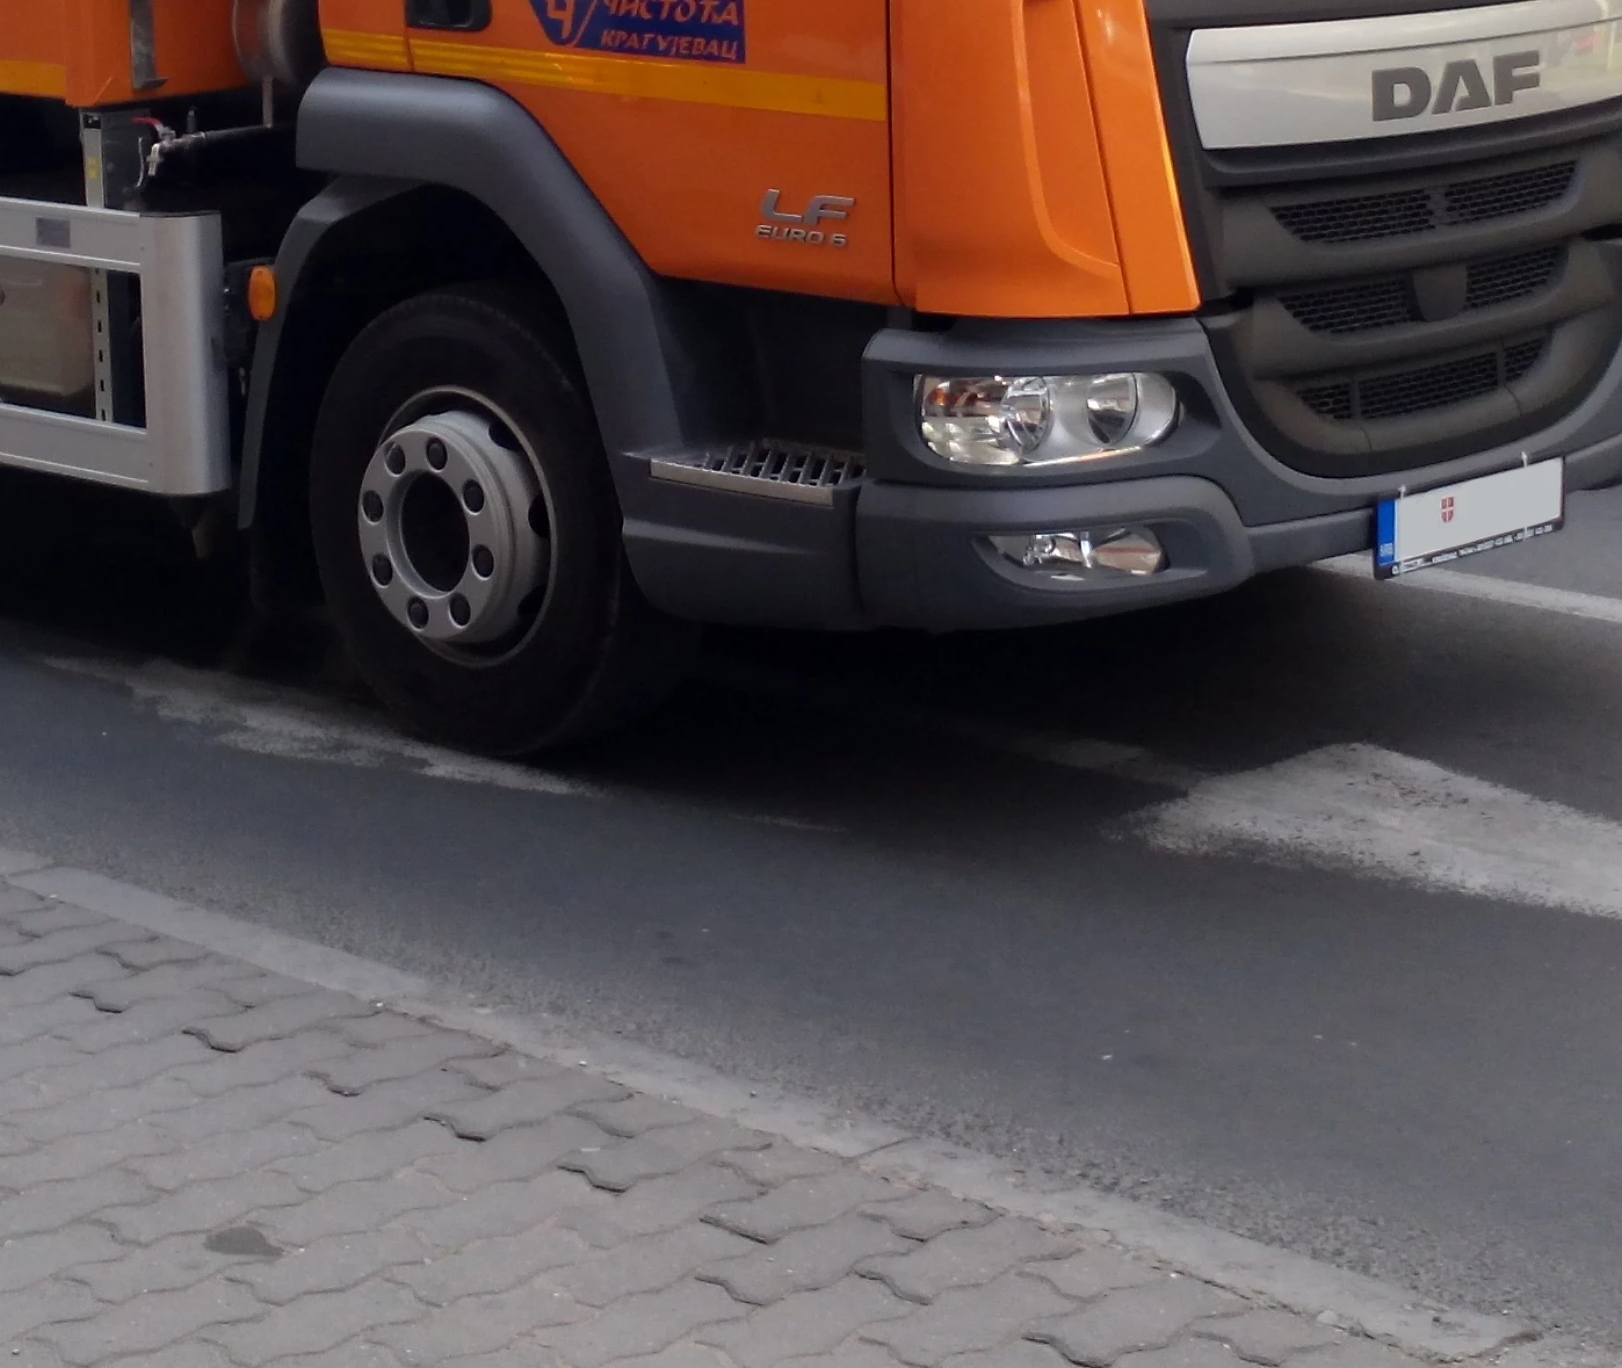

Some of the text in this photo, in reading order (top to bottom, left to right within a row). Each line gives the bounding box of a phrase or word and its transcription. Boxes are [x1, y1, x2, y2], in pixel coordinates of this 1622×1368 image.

[599, 29, 738, 61] КРАГУЈЕВАЦ
[1371, 49, 1540, 123] DAF
[761, 188, 855, 226] LF
[755, 224, 847, 248] EURO 6
